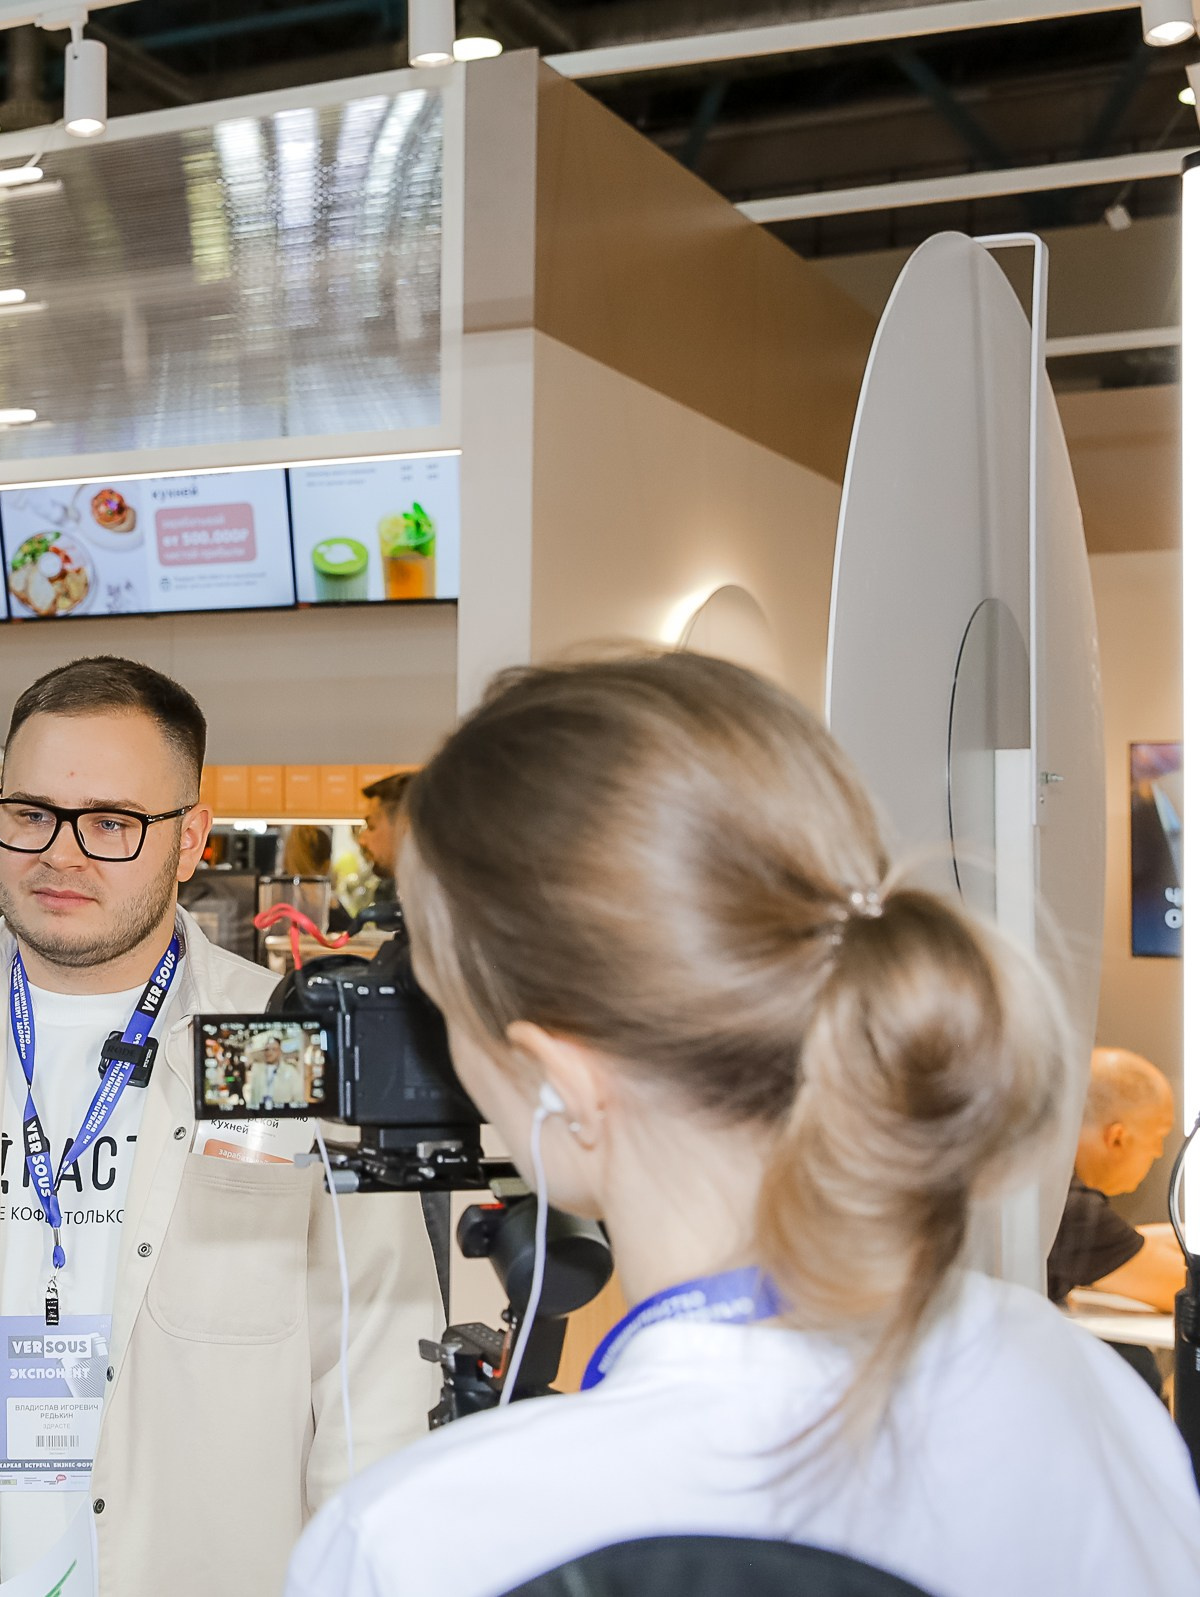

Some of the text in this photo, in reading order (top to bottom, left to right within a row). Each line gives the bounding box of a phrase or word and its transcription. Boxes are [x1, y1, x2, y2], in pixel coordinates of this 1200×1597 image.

[85, 1060, 124, 1131] ПРЕДПРИНИМАТЕЛЬ
[210, 1118, 249, 1135] кухней
[9, 1367, 90, 1380] ЭКСПОННТ
[15, 1404, 59, 1412] ВЛАДИСЛАВ
